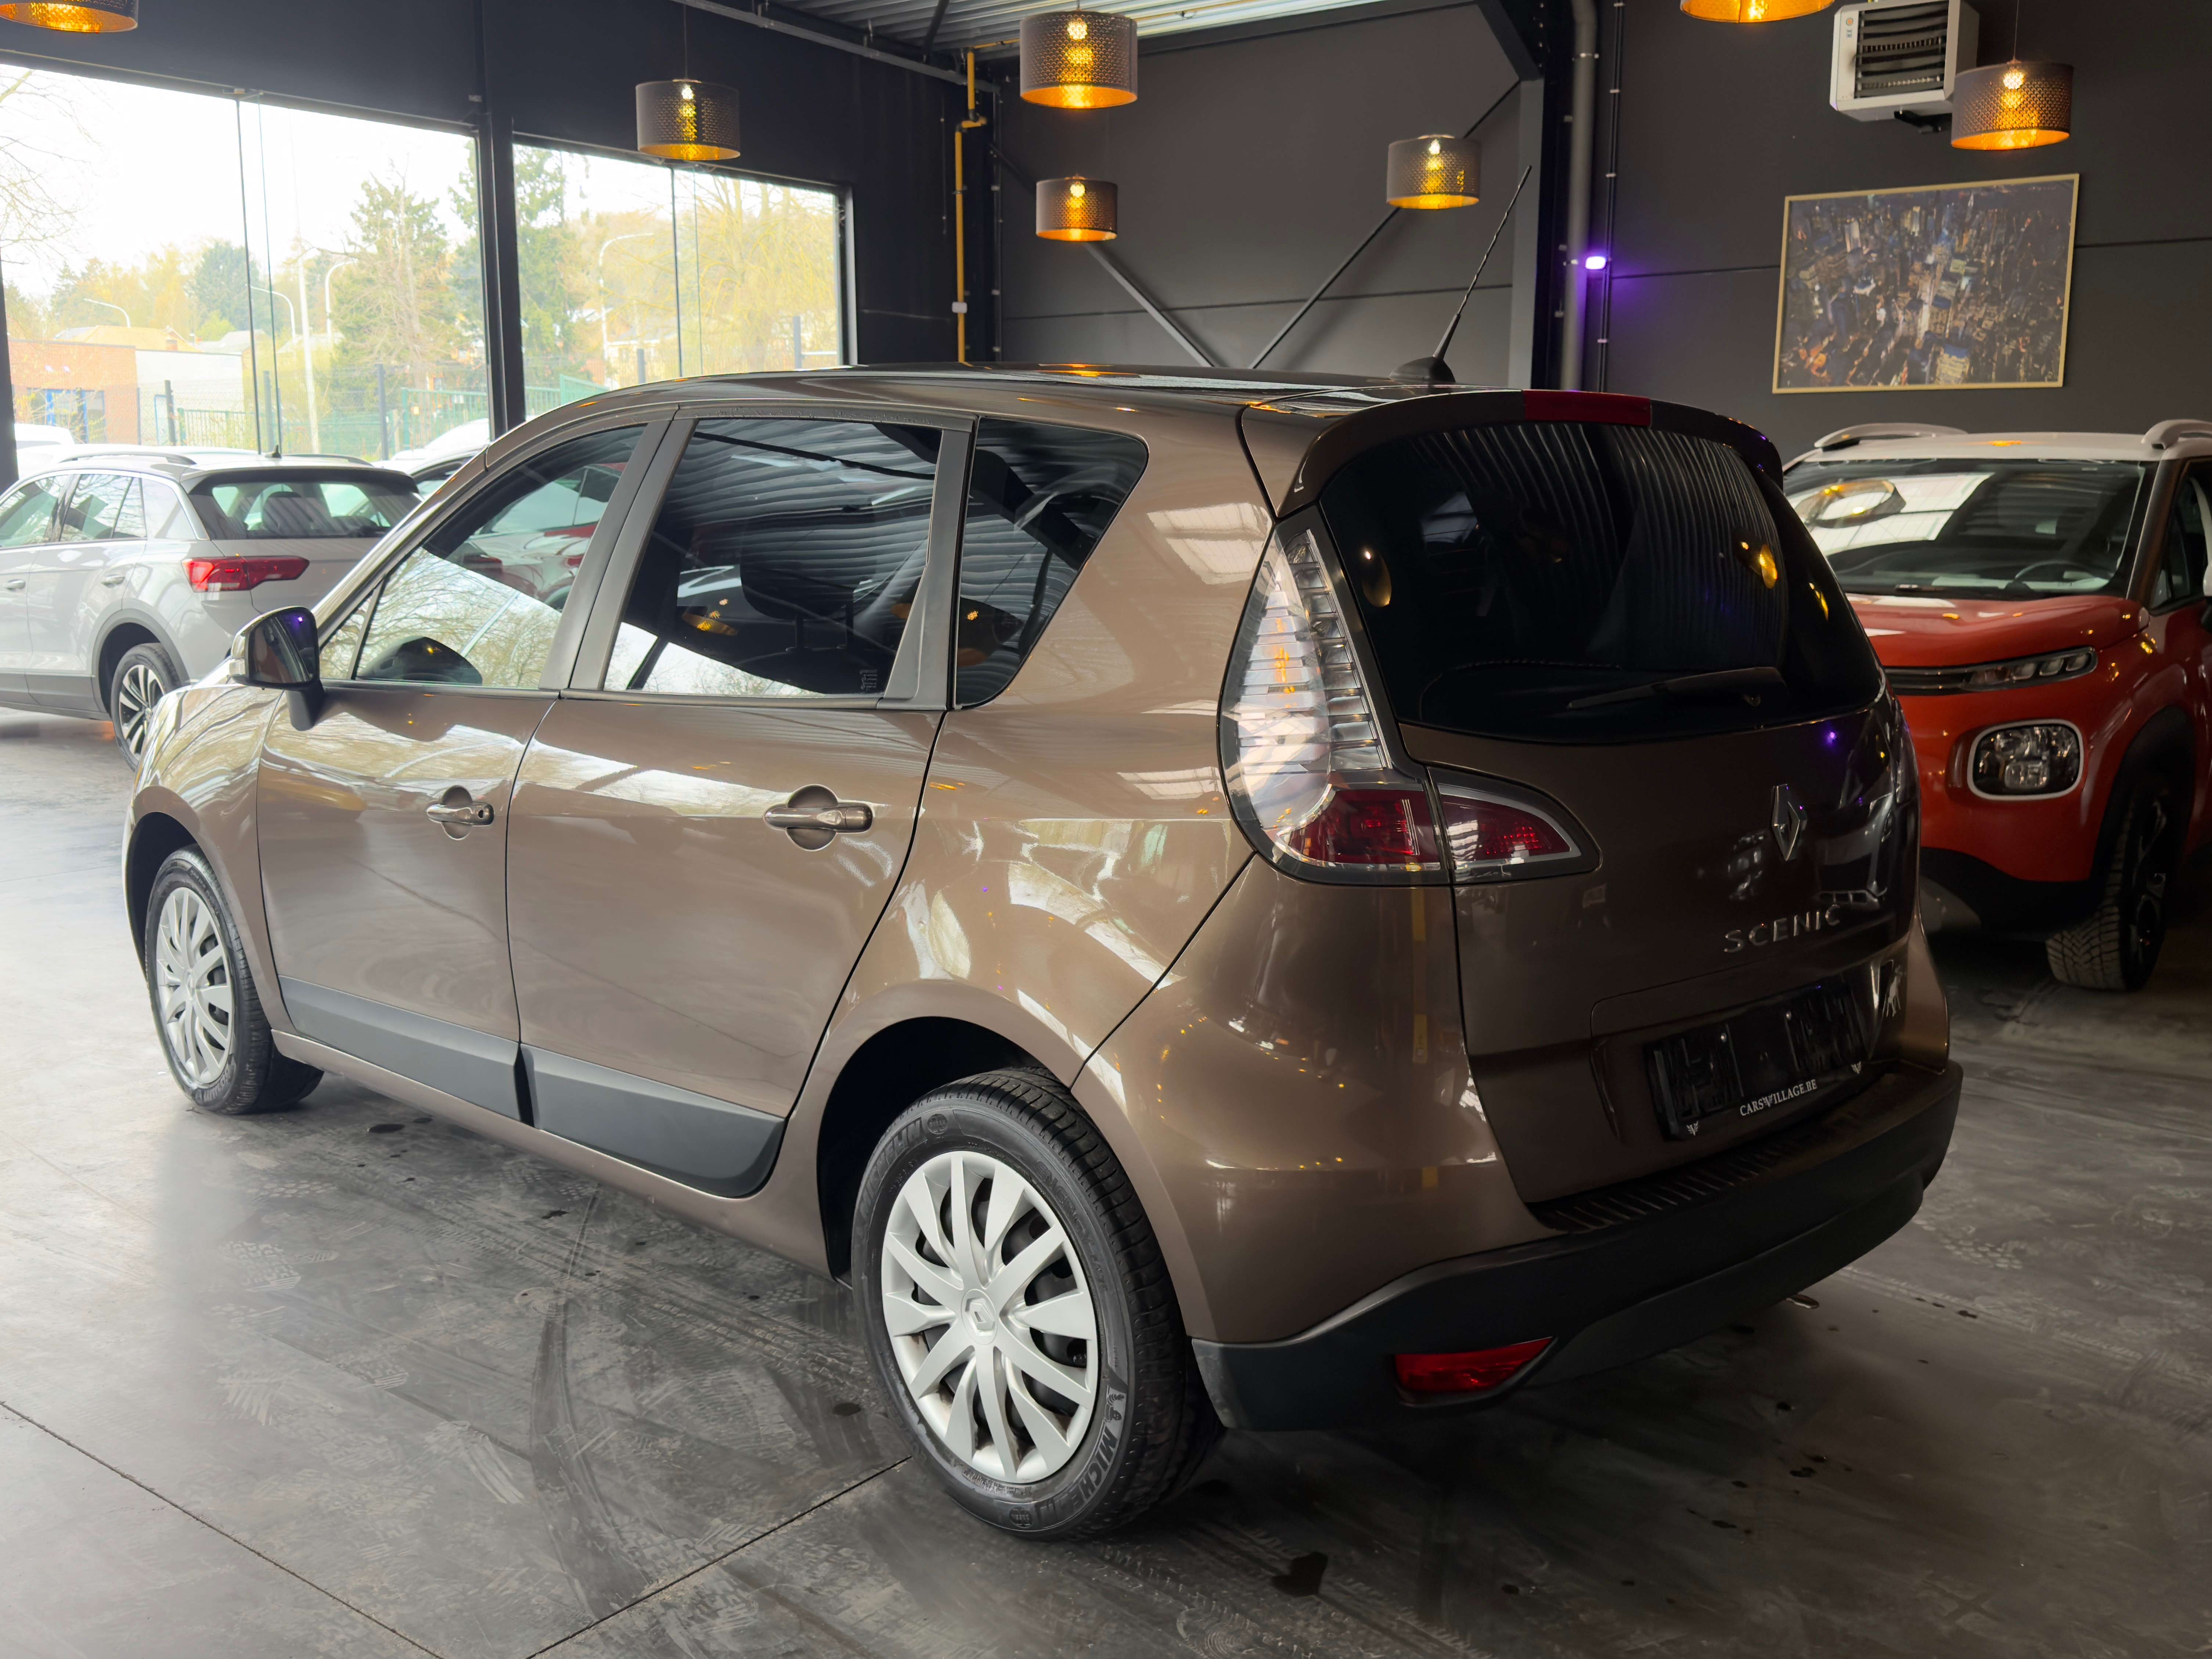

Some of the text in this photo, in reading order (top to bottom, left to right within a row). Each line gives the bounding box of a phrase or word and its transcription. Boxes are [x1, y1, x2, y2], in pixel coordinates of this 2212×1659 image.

[1724, 904, 1841, 953] SCENIC
[1740, 1079, 1817, 1116] CARSVILLAGE.BE
[1037, 1425, 1118, 1521] MICHELIN
